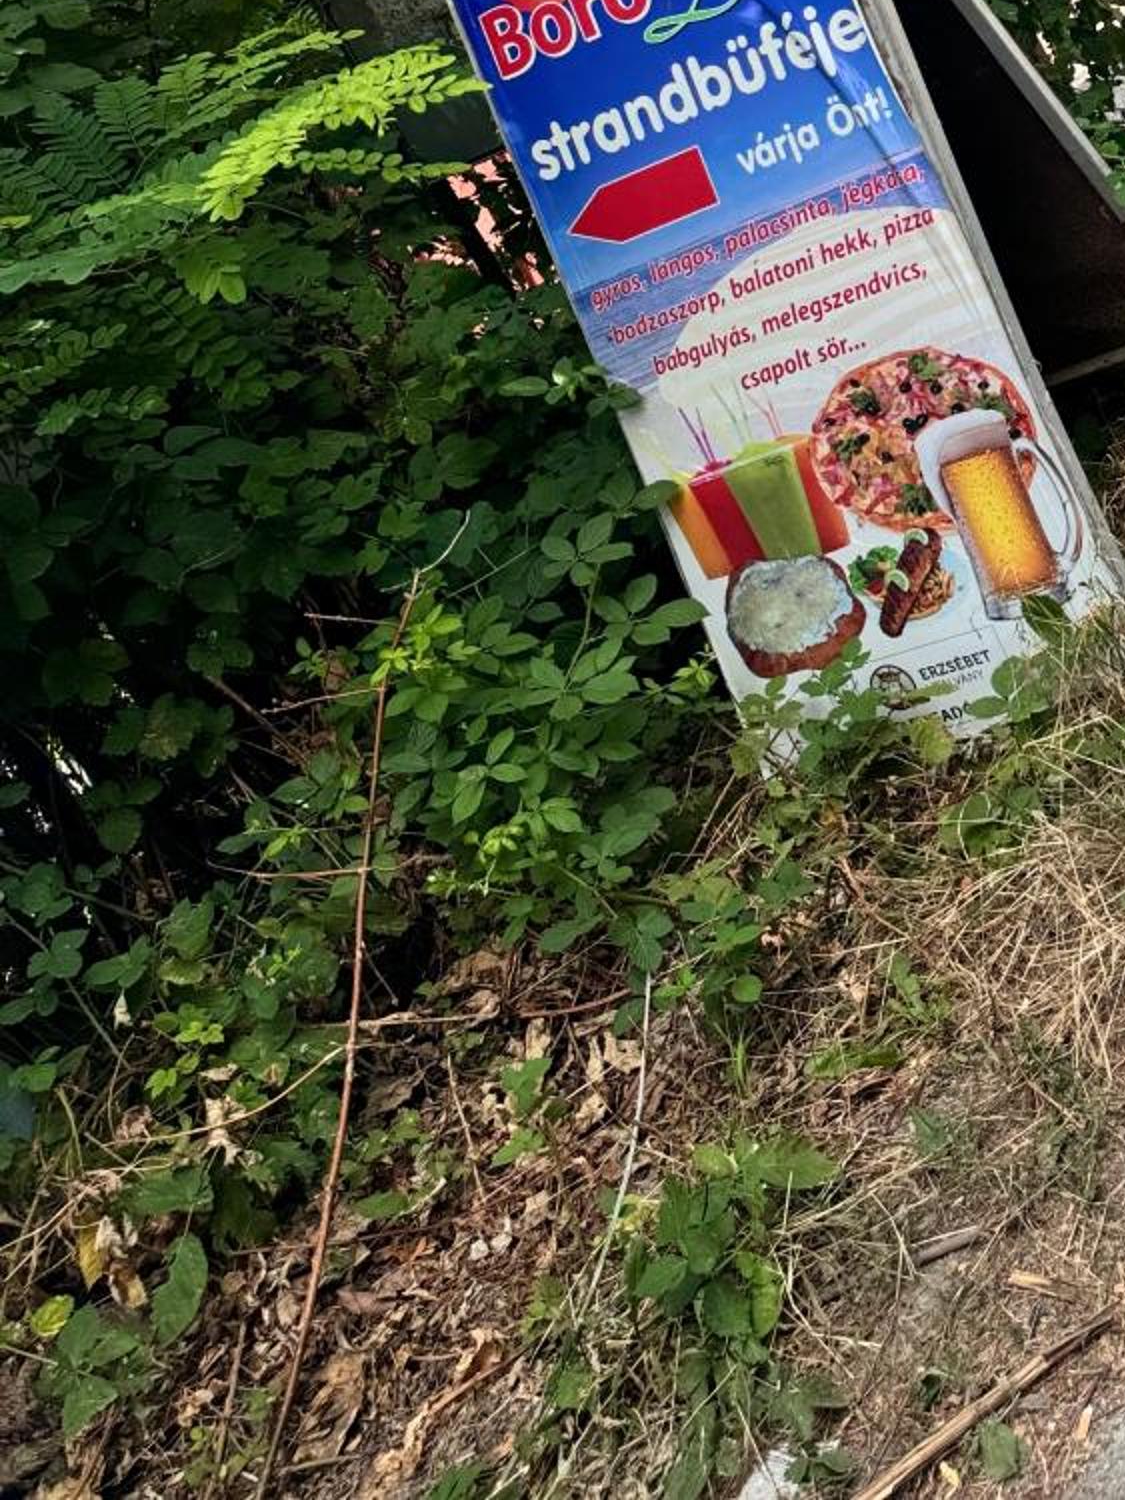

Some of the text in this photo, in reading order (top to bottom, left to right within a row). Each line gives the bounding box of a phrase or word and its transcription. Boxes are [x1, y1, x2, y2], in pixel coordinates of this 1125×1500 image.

[531, 5, 868, 182] strandbüféje
[736, 86, 893, 175] várja Önt!
[725, 199, 836, 258] palacsinta,
[612, 208, 935, 345] bodzaszörp, balatoni hekk, pizza
[653, 261, 928, 375] babgulyás, melegszendvics,
[740, 336, 867, 391] csapolt sör...
[918, 649, 992, 681] ERZSÉBET
